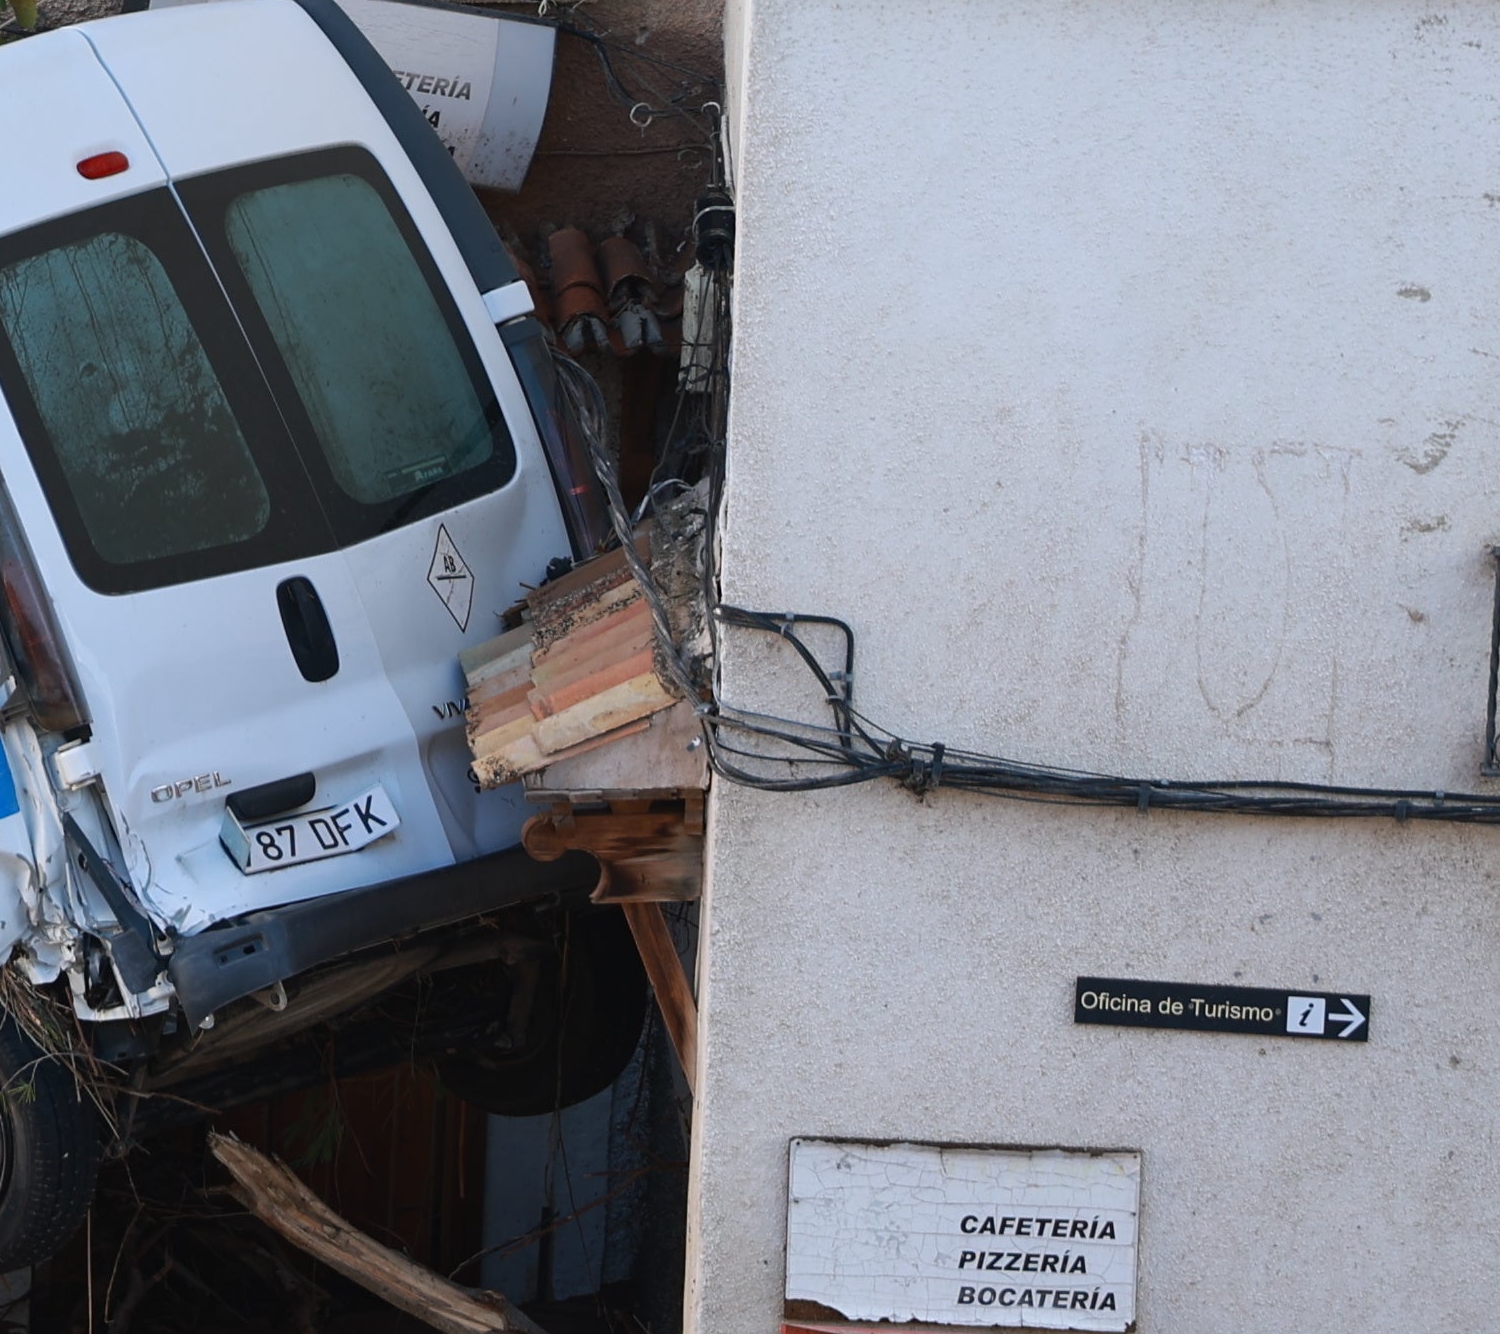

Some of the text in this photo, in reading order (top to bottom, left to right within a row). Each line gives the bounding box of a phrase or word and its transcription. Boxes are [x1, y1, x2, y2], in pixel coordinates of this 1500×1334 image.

[150, 770, 232, 803] OPEL
[307, 794, 388, 851] DFK
[1080, 990, 1151, 1013] Oficina
[1158, 996, 1184, 1015] de
[1190, 998, 1274, 1021] Turismo
[960, 1215, 1116, 1239] CAFETERÍA
[958, 1250, 1087, 1274] PIZZERÍA
[957, 1286, 1116, 1311] BOCATERÍA
